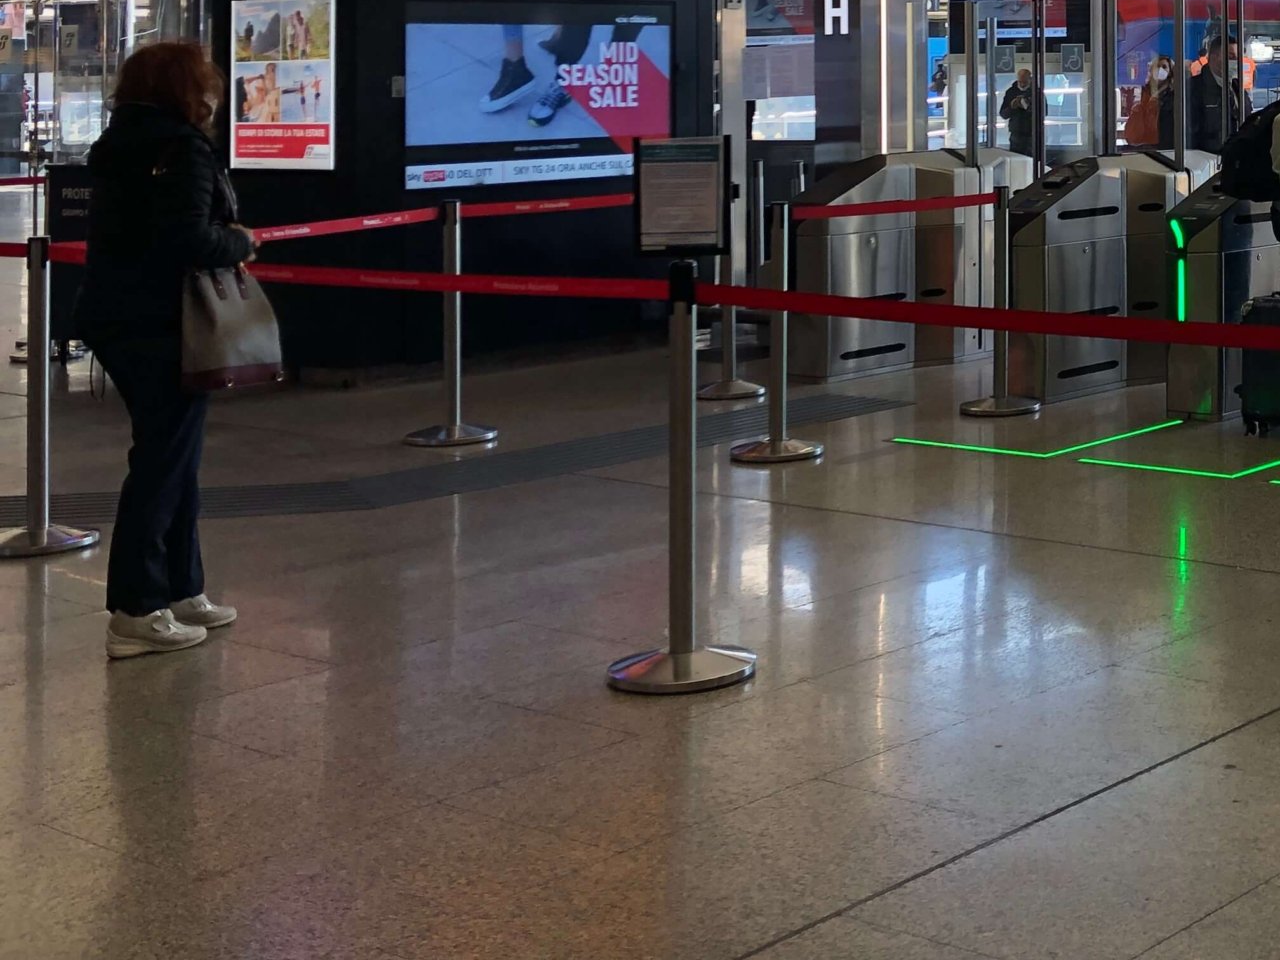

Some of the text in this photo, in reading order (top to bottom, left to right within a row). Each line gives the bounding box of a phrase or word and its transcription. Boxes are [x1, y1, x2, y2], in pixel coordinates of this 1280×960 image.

[600, 42, 639, 63] MID
[557, 64, 639, 87] SEASON
[589, 86, 640, 109] SALE
[456, 169, 474, 180] DEL
[513, 166, 531, 176] SKY
[532, 165, 543, 175] TG
[557, 162, 576, 173] ORA
[577, 160, 607, 172] ANCHE
